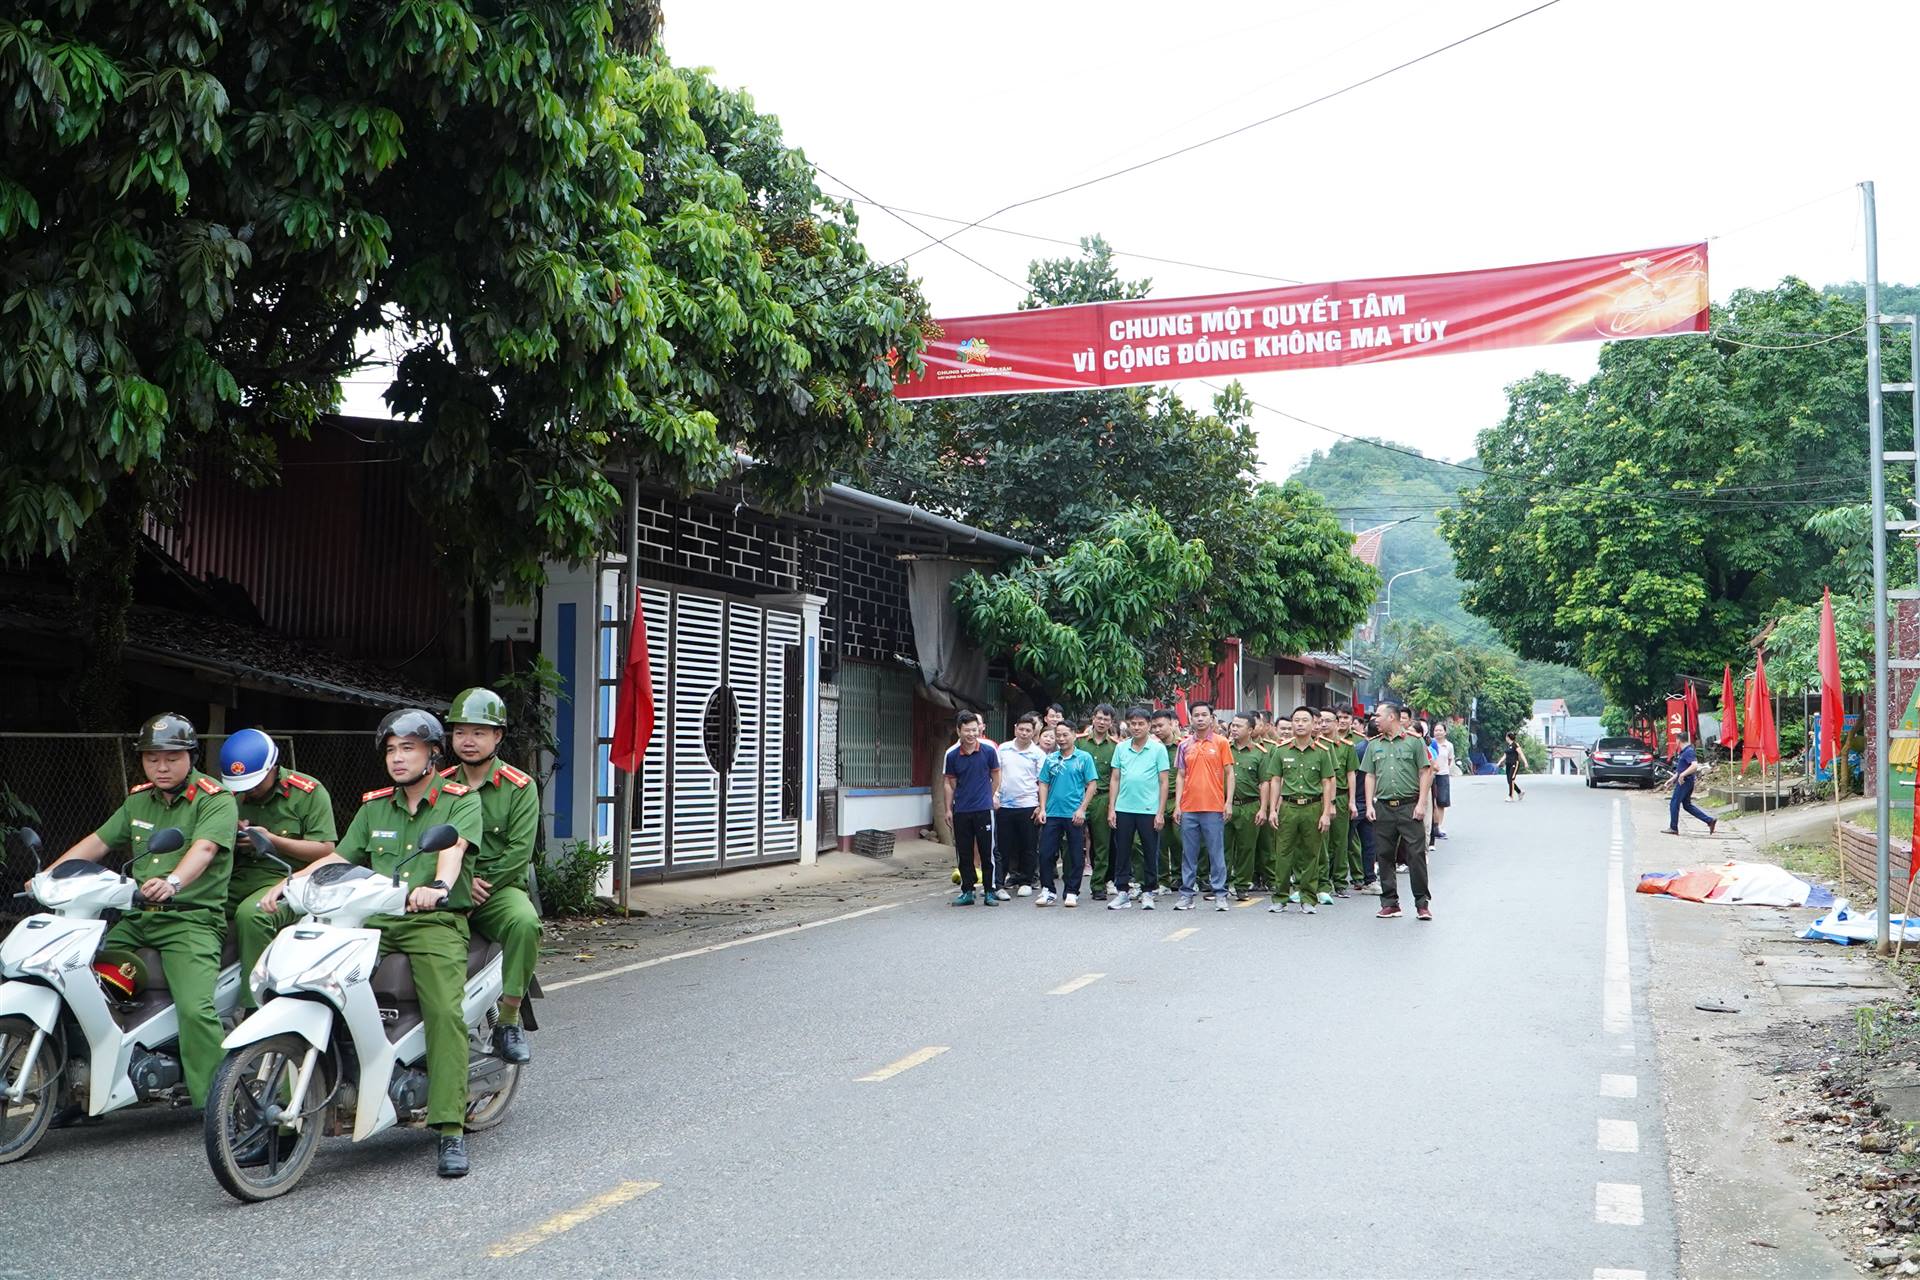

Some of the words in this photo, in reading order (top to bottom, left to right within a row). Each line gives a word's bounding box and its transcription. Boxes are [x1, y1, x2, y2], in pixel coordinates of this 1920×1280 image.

[1109, 314, 1193, 341] CHUNG
[1201, 306, 1255, 335] MỘT
[1262, 295, 1342, 329] QUYẾT
[1349, 293, 1406, 320] TÂM
[1072, 347, 1096, 373] VÌ
[1103, 345, 1170, 373] CỘNG
[1177, 336, 1246, 365] ĐỒNG
[1254, 330, 1342, 358] KHÔNG
[1350, 326, 1393, 349] MA
[1400, 319, 1448, 344] TÚY
